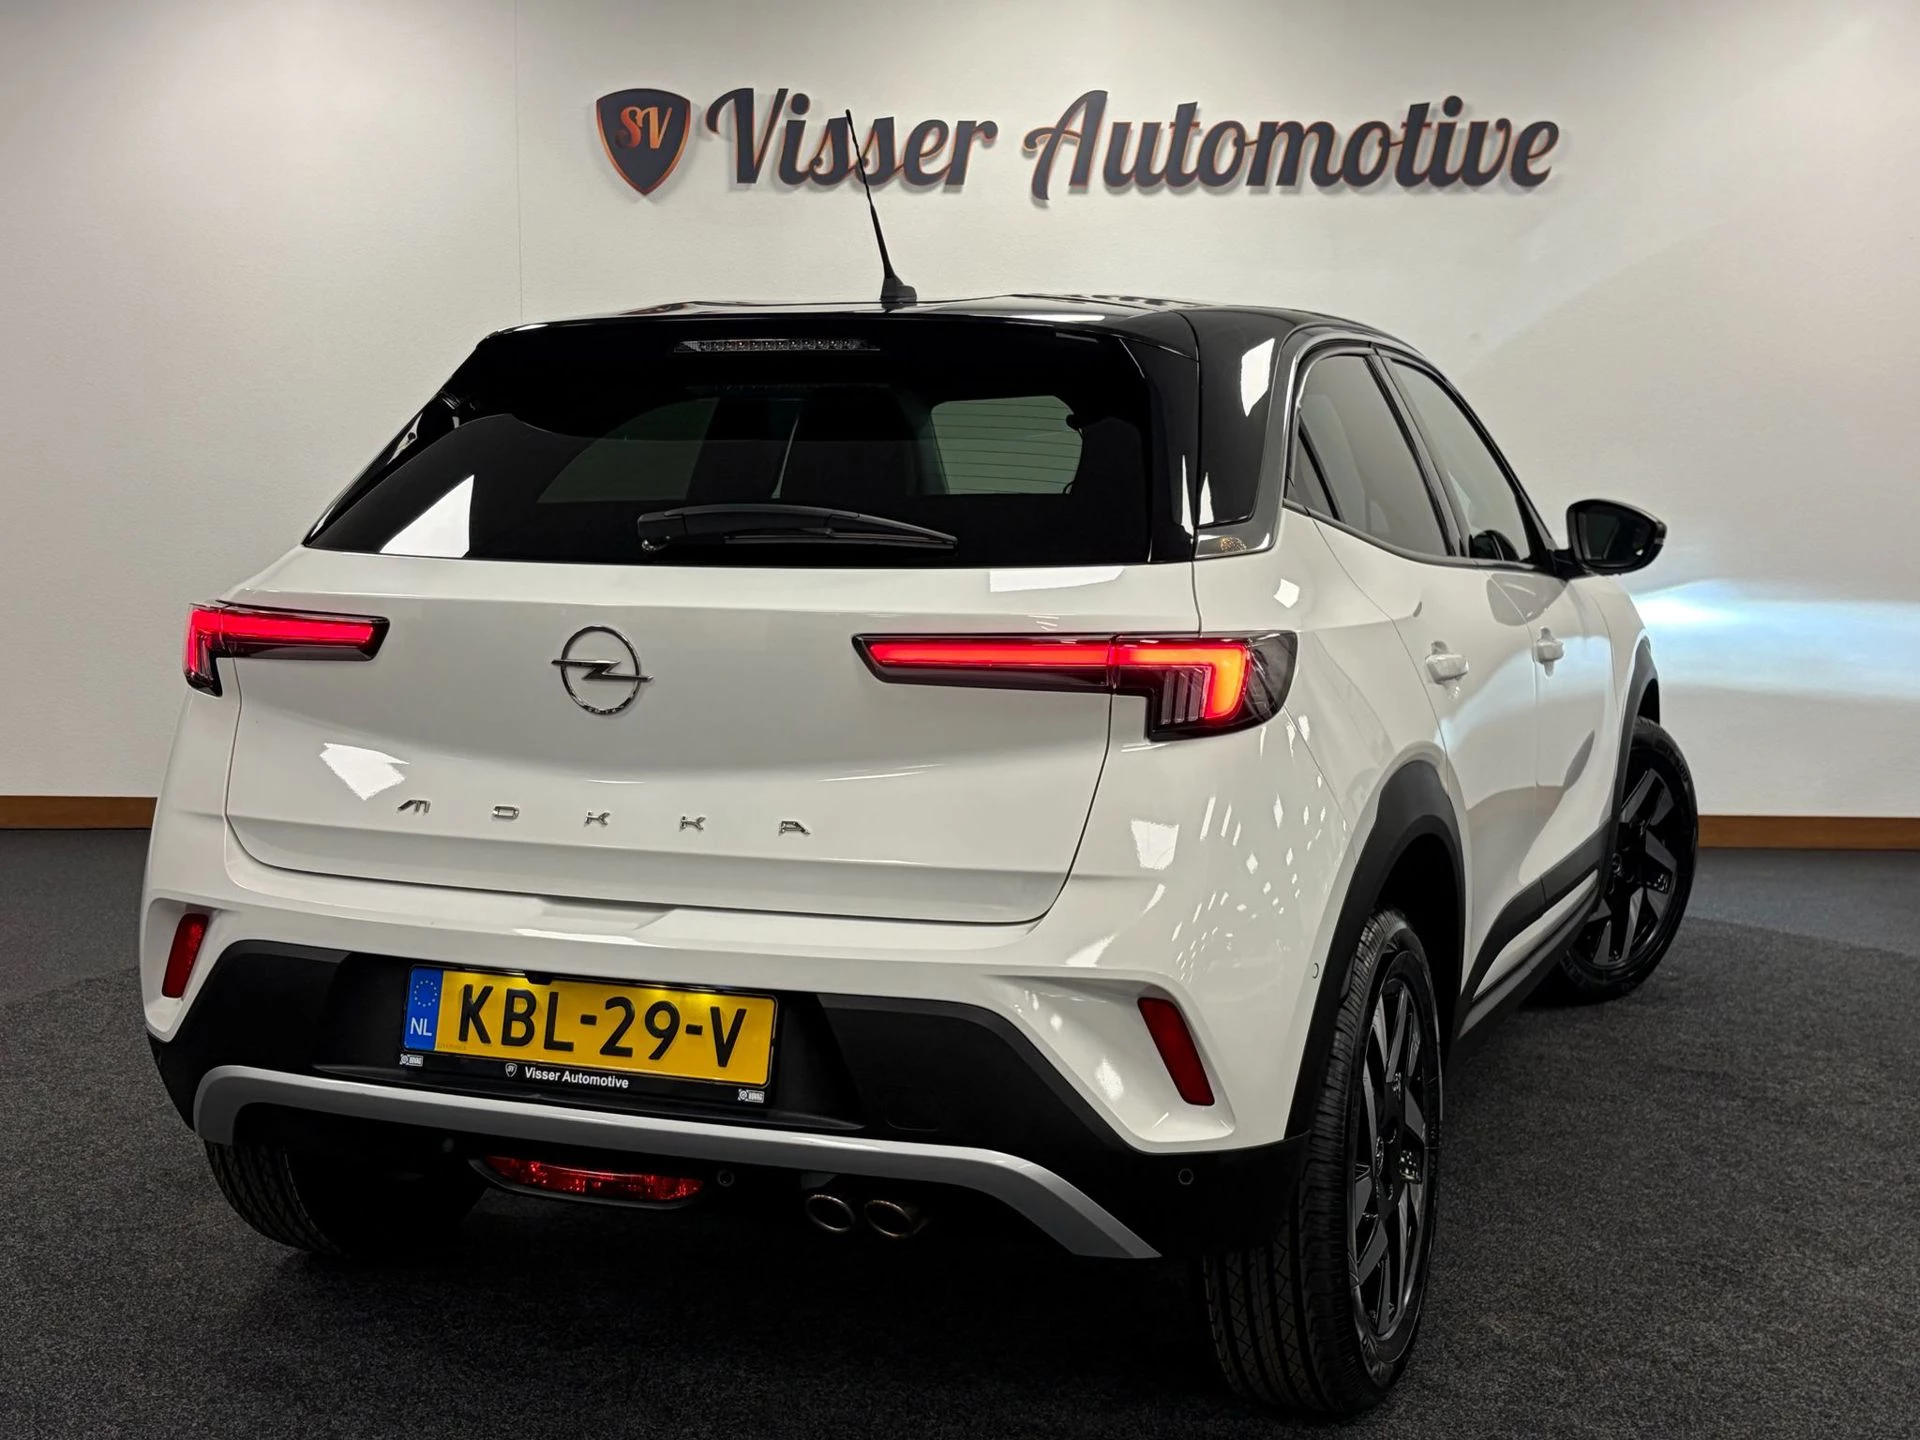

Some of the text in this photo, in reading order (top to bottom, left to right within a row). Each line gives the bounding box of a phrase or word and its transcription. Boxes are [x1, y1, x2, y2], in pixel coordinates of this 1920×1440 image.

[615, 105, 673, 150] SV
[705, 87, 1560, 200] Visser Automotive
[409, 1016, 433, 1037] NL
[458, 983, 747, 1068] KBL-29-V
[524, 1066, 630, 1089] Visser Automotive
